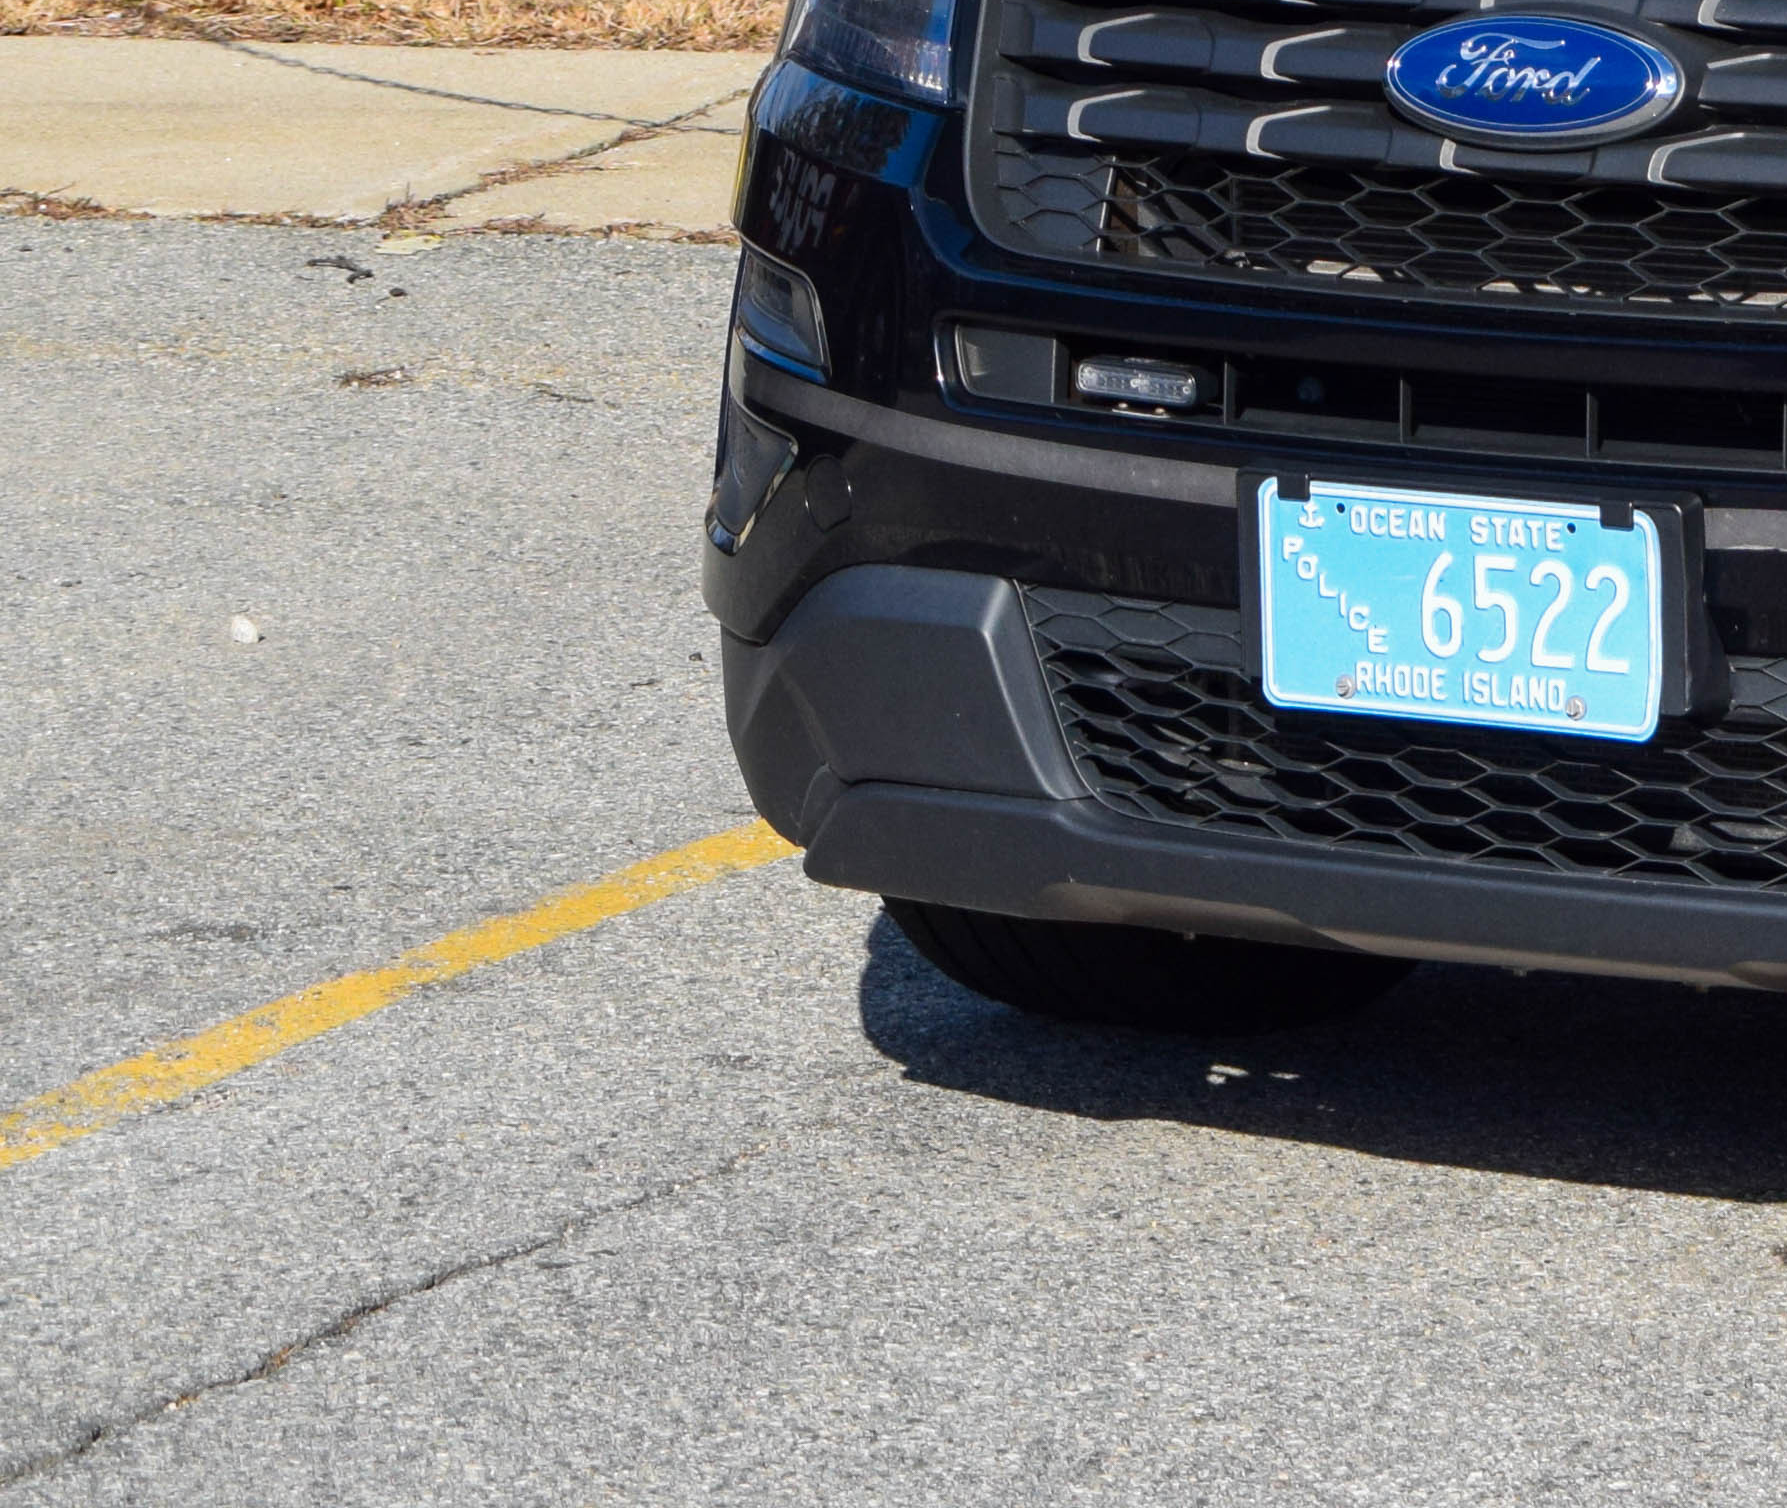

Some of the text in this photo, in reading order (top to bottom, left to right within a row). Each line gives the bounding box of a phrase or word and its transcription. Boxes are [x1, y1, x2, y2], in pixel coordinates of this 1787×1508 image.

[1437, 31, 1601, 106] Ford
[1349, 505, 1563, 552] OCEAN STATE
[1282, 535, 1389, 655] POLICE
[1420, 550, 1632, 676] 6522
[1353, 660, 1568, 713] RHODE ISLAND
